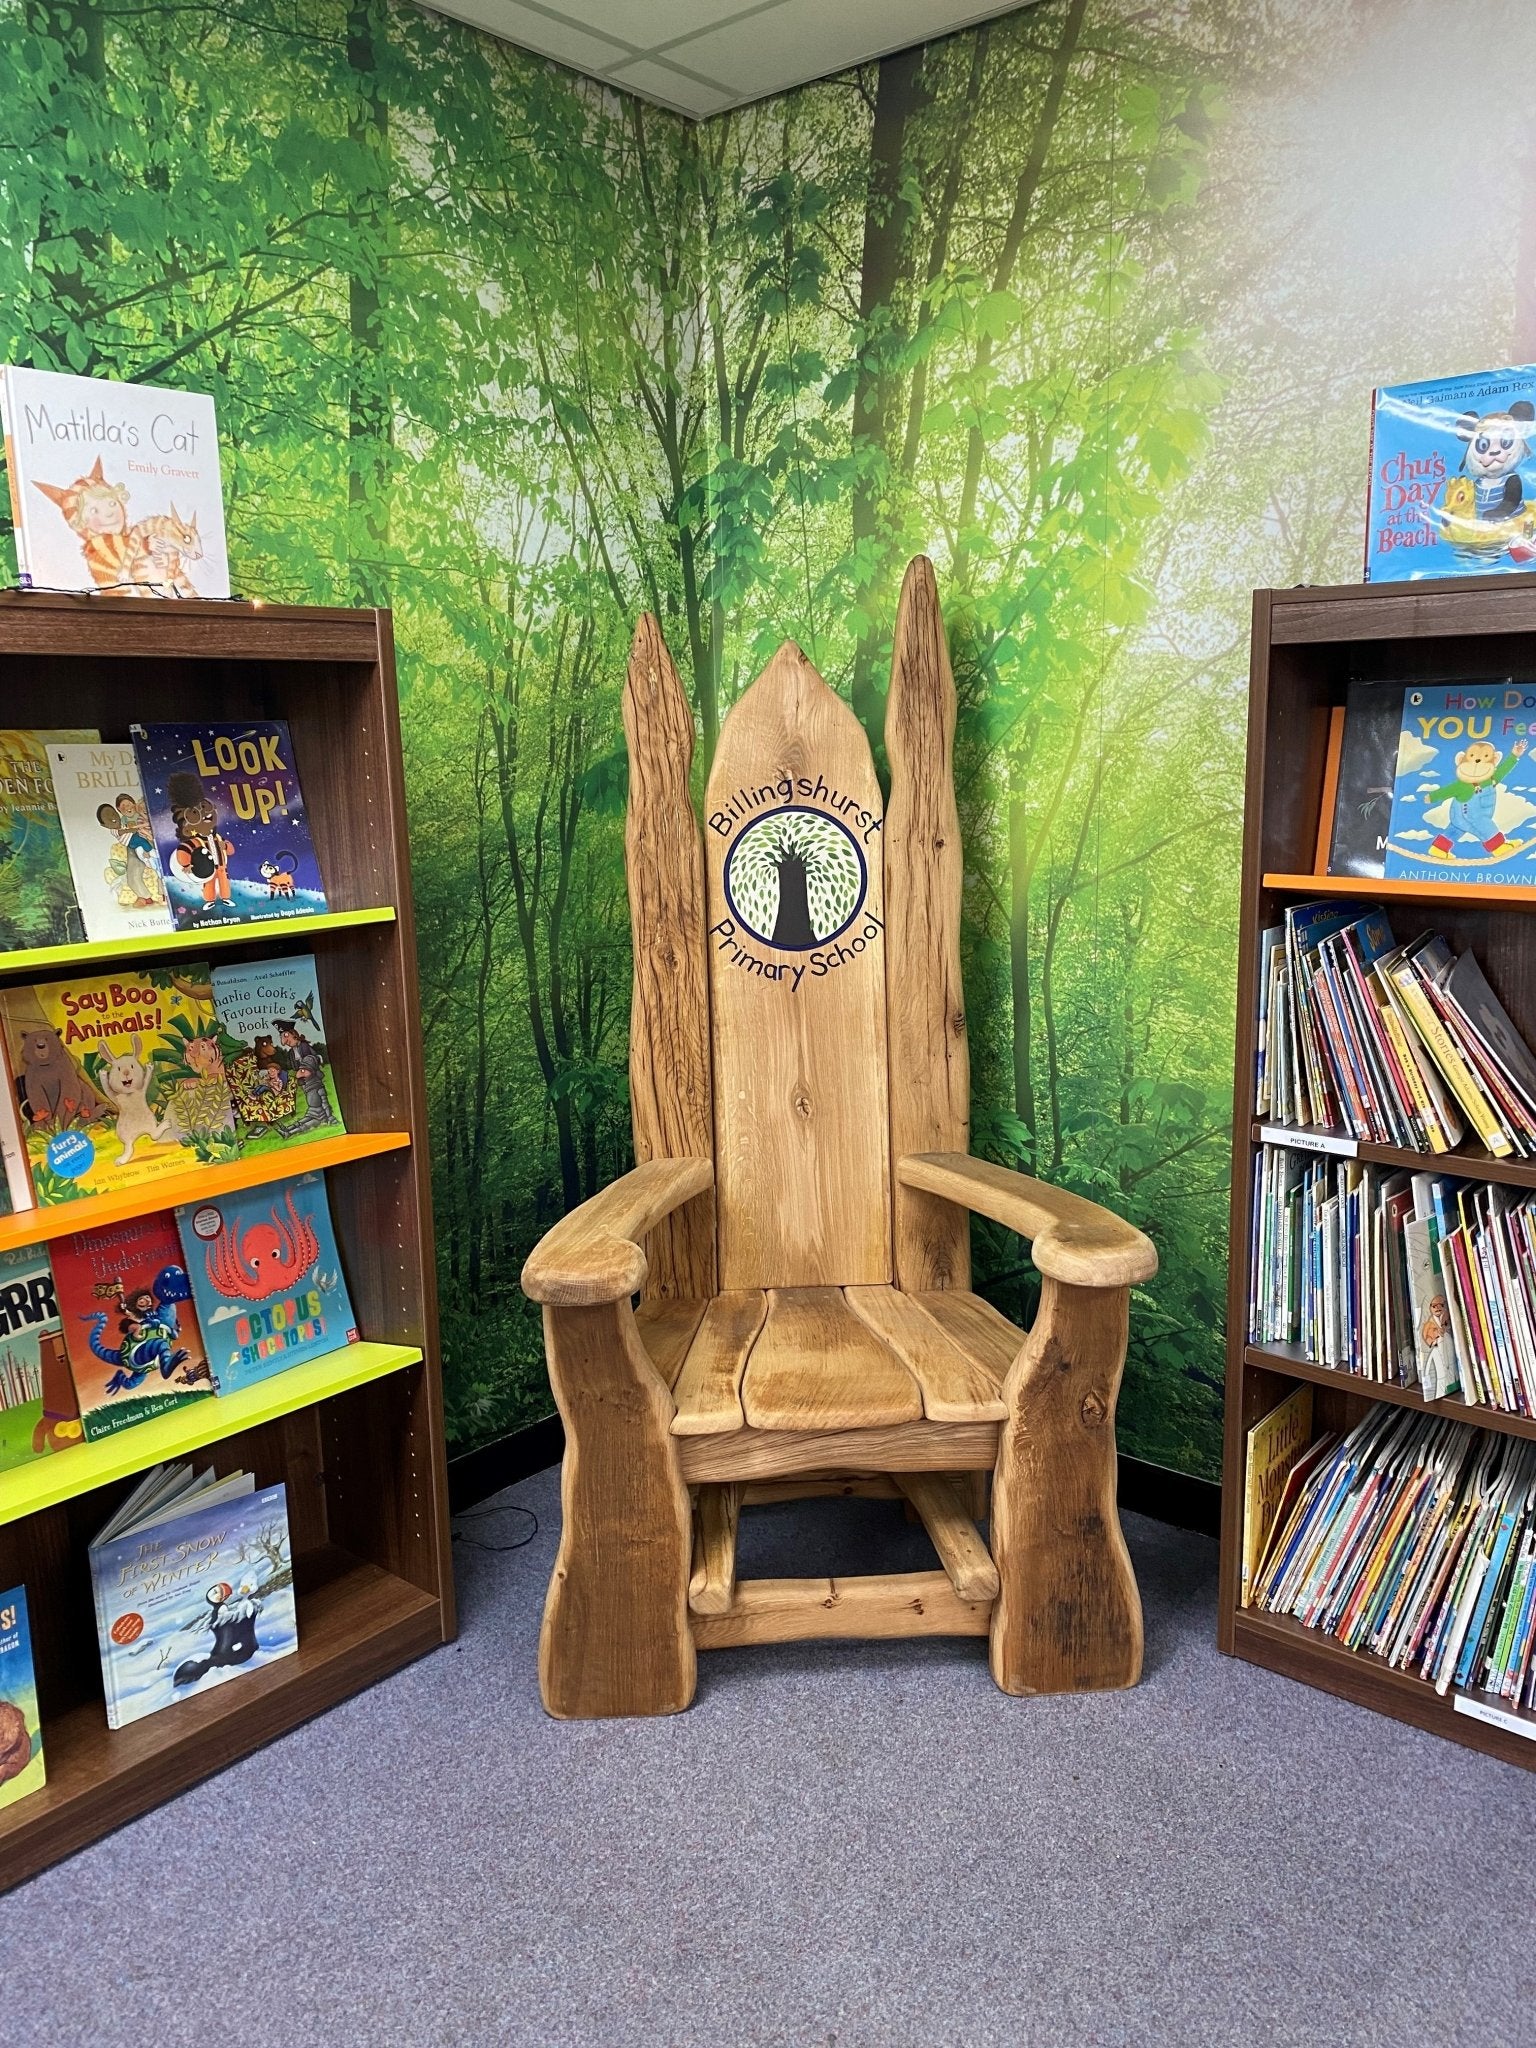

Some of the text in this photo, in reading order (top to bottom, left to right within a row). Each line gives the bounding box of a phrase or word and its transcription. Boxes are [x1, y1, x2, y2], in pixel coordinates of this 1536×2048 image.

[1425, 391, 1467, 405] Gaiman
[1468, 390, 1475, 398] &
[1476, 384, 1509, 397] Adam
[1512, 381, 1534, 392] Rex
[24, 403, 199, 455] Matilda's Cat
[127, 459, 199, 479] Emily Gravett
[1380, 451, 1447, 484] Chu's
[1379, 477, 1447, 513] Day
[1387, 512, 1403, 526] at
[1376, 524, 1438, 554] Beach
[1445, 690, 1536, 711] How Do
[1416, 716, 1493, 740] YOU
[10, 761, 42, 774] THE
[89, 751, 117, 770] My
[192, 735, 287, 777] LOOK
[12, 802, 45, 813] Jeannie
[229, 780, 289, 825] UP!
[708, 774, 883, 845] Billingshurst
[1399, 869, 1536, 886] ANTHONY BROWN
[128, 919, 148, 930] Nick
[709, 911, 885, 993] Primary School
[253, 973, 268, 981] Axel
[61, 983, 158, 1017] Say Boo
[212, 985, 297, 1008] harlie Cook's
[112, 1011, 124, 1019] the
[221, 1001, 287, 1024] Favourite
[65, 1007, 163, 1045] Animals!
[238, 1017, 270, 1034] Book
[1430, 1026, 1457, 1064] Stories
[51, 1134, 77, 1155] furry
[53, 1139, 88, 1166] animals
[1290, 1137, 1319, 1148] PICTURE
[146, 1165, 160, 1174] Tim
[235, 1289, 322, 1346] OCTOPUS
[90, 1424, 111, 1437] Claire
[111, 1413, 145, 1429] Freedman
[144, 1406, 150, 1416] &
[150, 1403, 164, 1413] Ben
[116, 1530, 228, 1588] FIRST SNOW
[135, 1541, 161, 1561] THE
[1479, 1710, 1503, 1722] PICTURE
